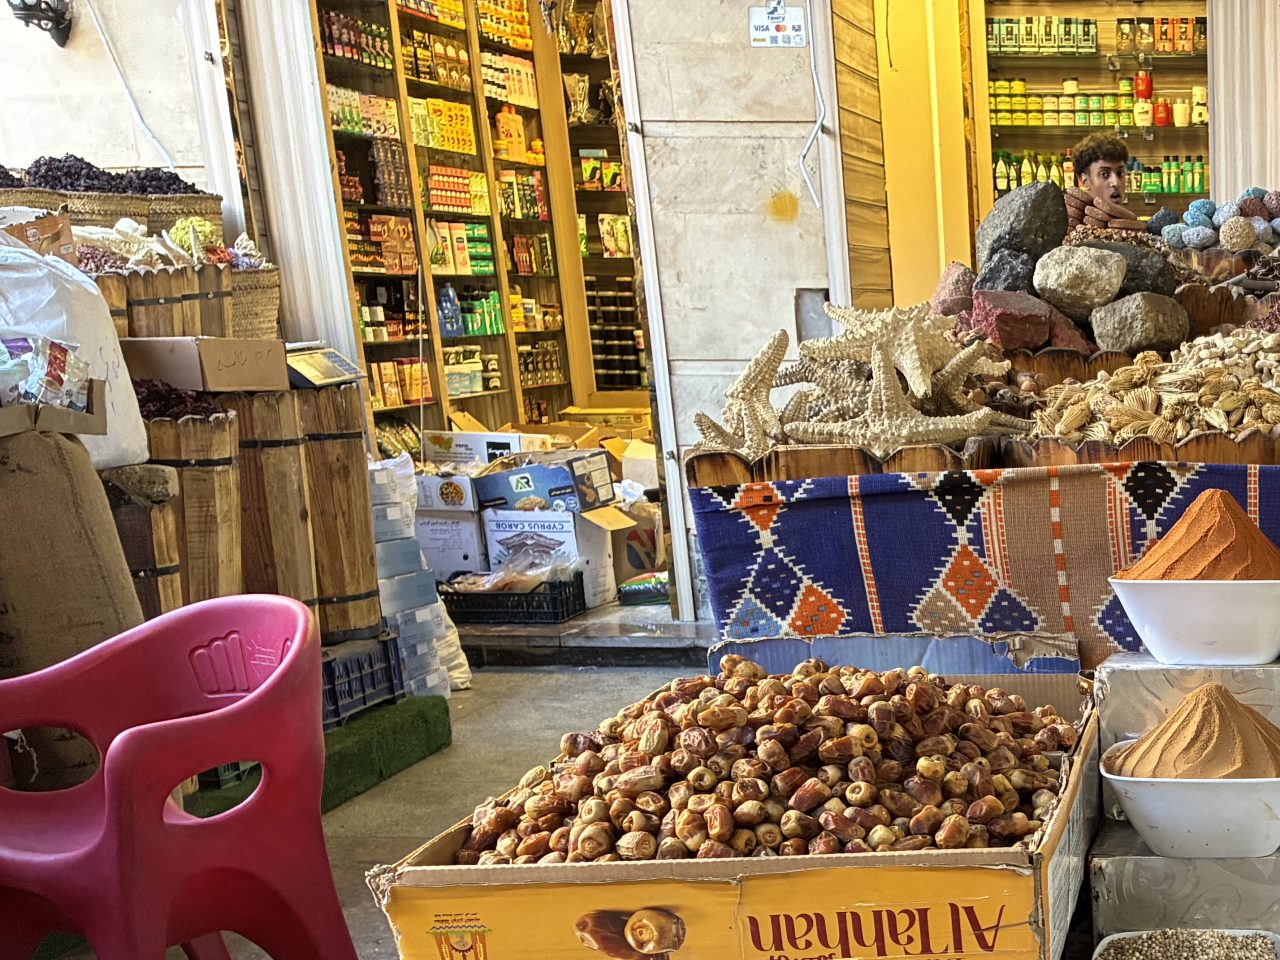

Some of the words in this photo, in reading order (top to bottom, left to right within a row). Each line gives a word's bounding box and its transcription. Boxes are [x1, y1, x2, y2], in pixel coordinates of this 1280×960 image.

[753, 24, 770, 32] VISA
[495, 522, 525, 530] CAROB
[528, 522, 564, 530] CYPRUS
